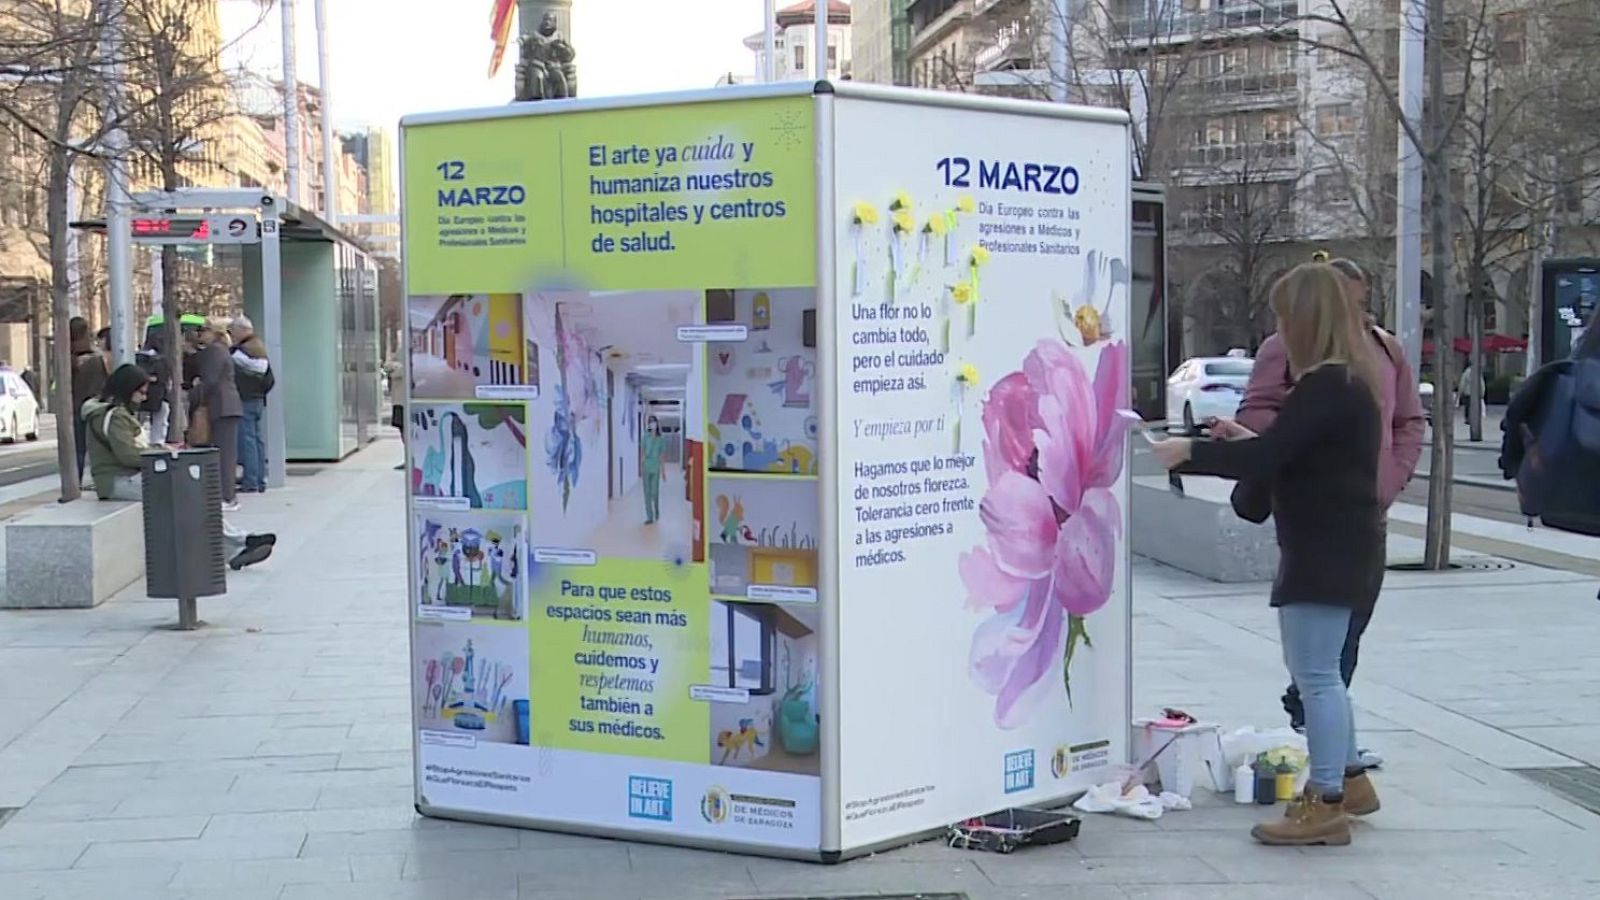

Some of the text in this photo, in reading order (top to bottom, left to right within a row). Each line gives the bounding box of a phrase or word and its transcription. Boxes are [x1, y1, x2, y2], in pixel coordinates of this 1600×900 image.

[590, 135, 754, 167] El arte ya cuida y
[437, 161, 464, 180] 12
[590, 169, 773, 194] humaniza nuestros
[936, 157, 1079, 195] 12 MARZO
[438, 186, 526, 207] MARZO
[591, 199, 786, 227] hospitales y centros
[998, 202, 1034, 219] Europeo
[1038, 207, 1064, 219] contra
[1068, 207, 1080, 221] las
[592, 231, 675, 252] de salud.
[979, 221, 1026, 236] agresiones
[1029, 226, 1035, 235] a
[1075, 228, 1080, 241] y
[979, 239, 1080, 255] Profesionales Sanitarios
[852, 302, 932, 321] Una flor no lo
[852, 326, 930, 346] cambia todo,
[852, 349, 945, 373] pero el cuidado
[853, 374, 904, 396] empieza
[853, 418, 863, 438] Y
[864, 417, 912, 441] empieza
[914, 418, 935, 438] por
[854, 452, 976, 480] Hagamos que lo mejor
[854, 477, 970, 500] de nosotros florezca.
[855, 496, 975, 523] Tolerancia cero frente
[855, 522, 953, 545] a las agresiones a
[855, 549, 906, 568] médicos.
[561, 580, 672, 602] Para que estos
[546, 605, 687, 627] espacios sean más
[582, 624, 653, 650] humanos,
[574, 650, 659, 673] cuidemos y
[580, 673, 654, 695] respetemos
[580, 695, 654, 715] también a
[569, 718, 665, 740] sus médicos.
